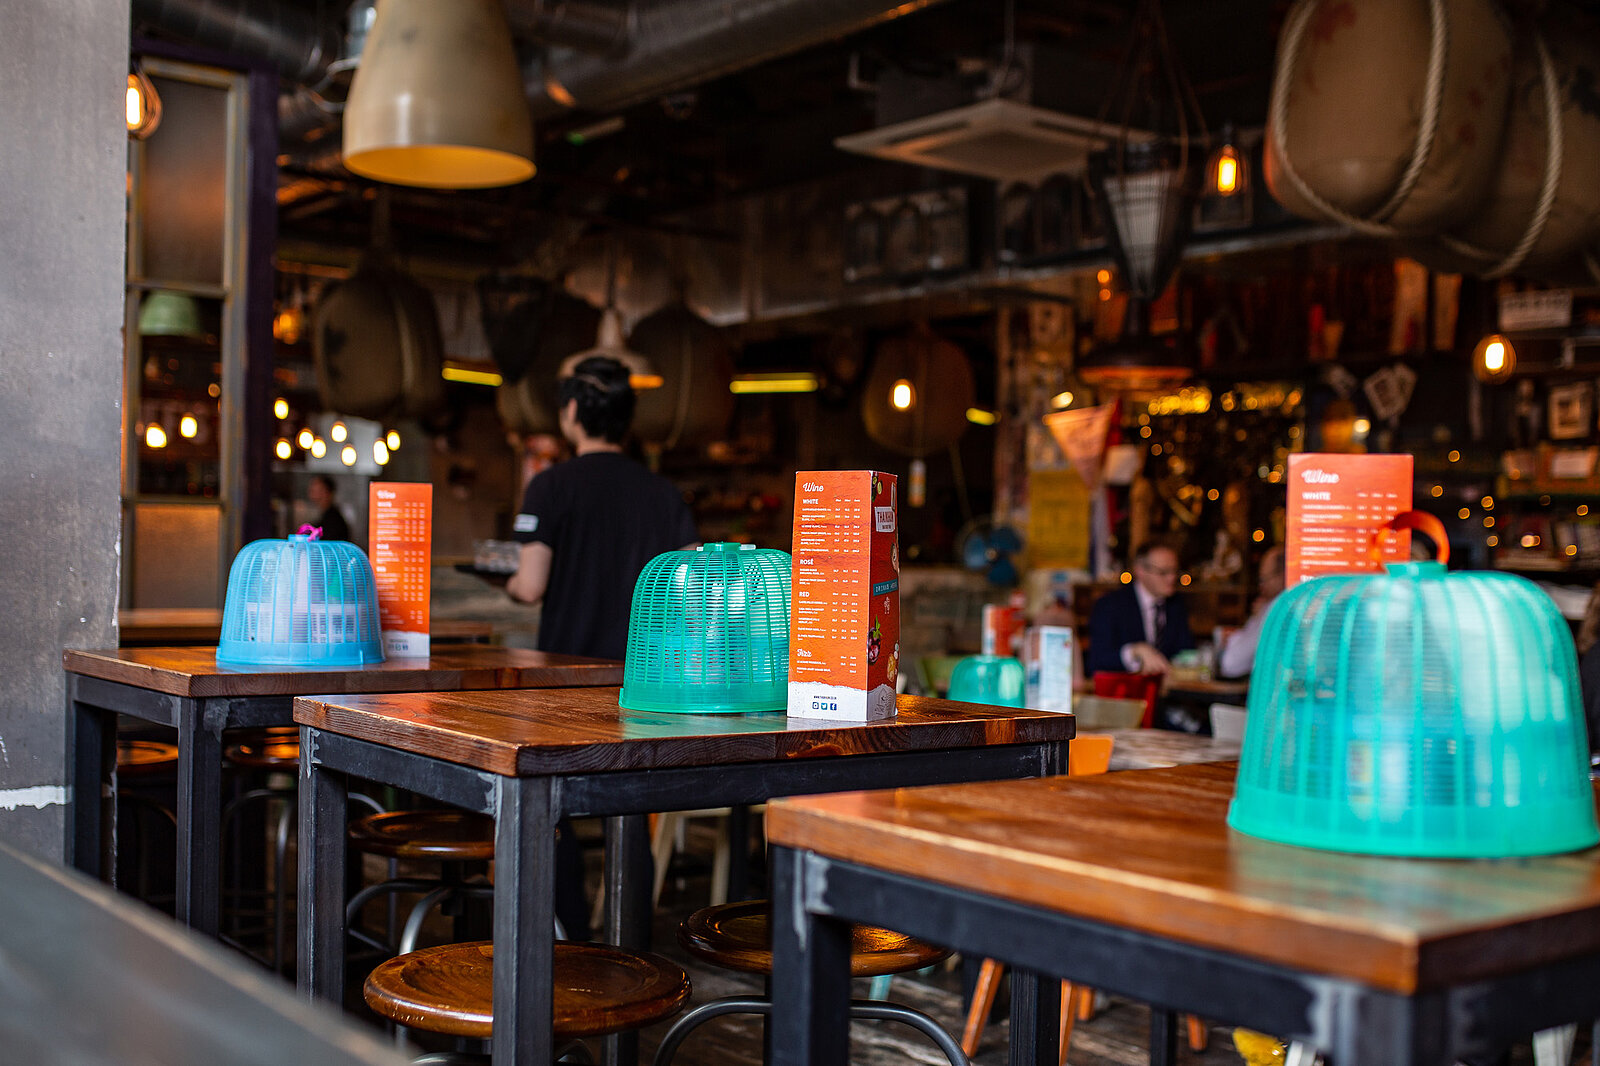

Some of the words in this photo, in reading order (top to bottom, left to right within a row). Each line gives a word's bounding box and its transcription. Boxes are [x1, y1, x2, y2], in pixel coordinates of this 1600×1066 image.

[1301, 469, 1339, 484] Wine
[802, 482, 824, 492] Wine
[1302, 491, 1331, 500] WHITE
